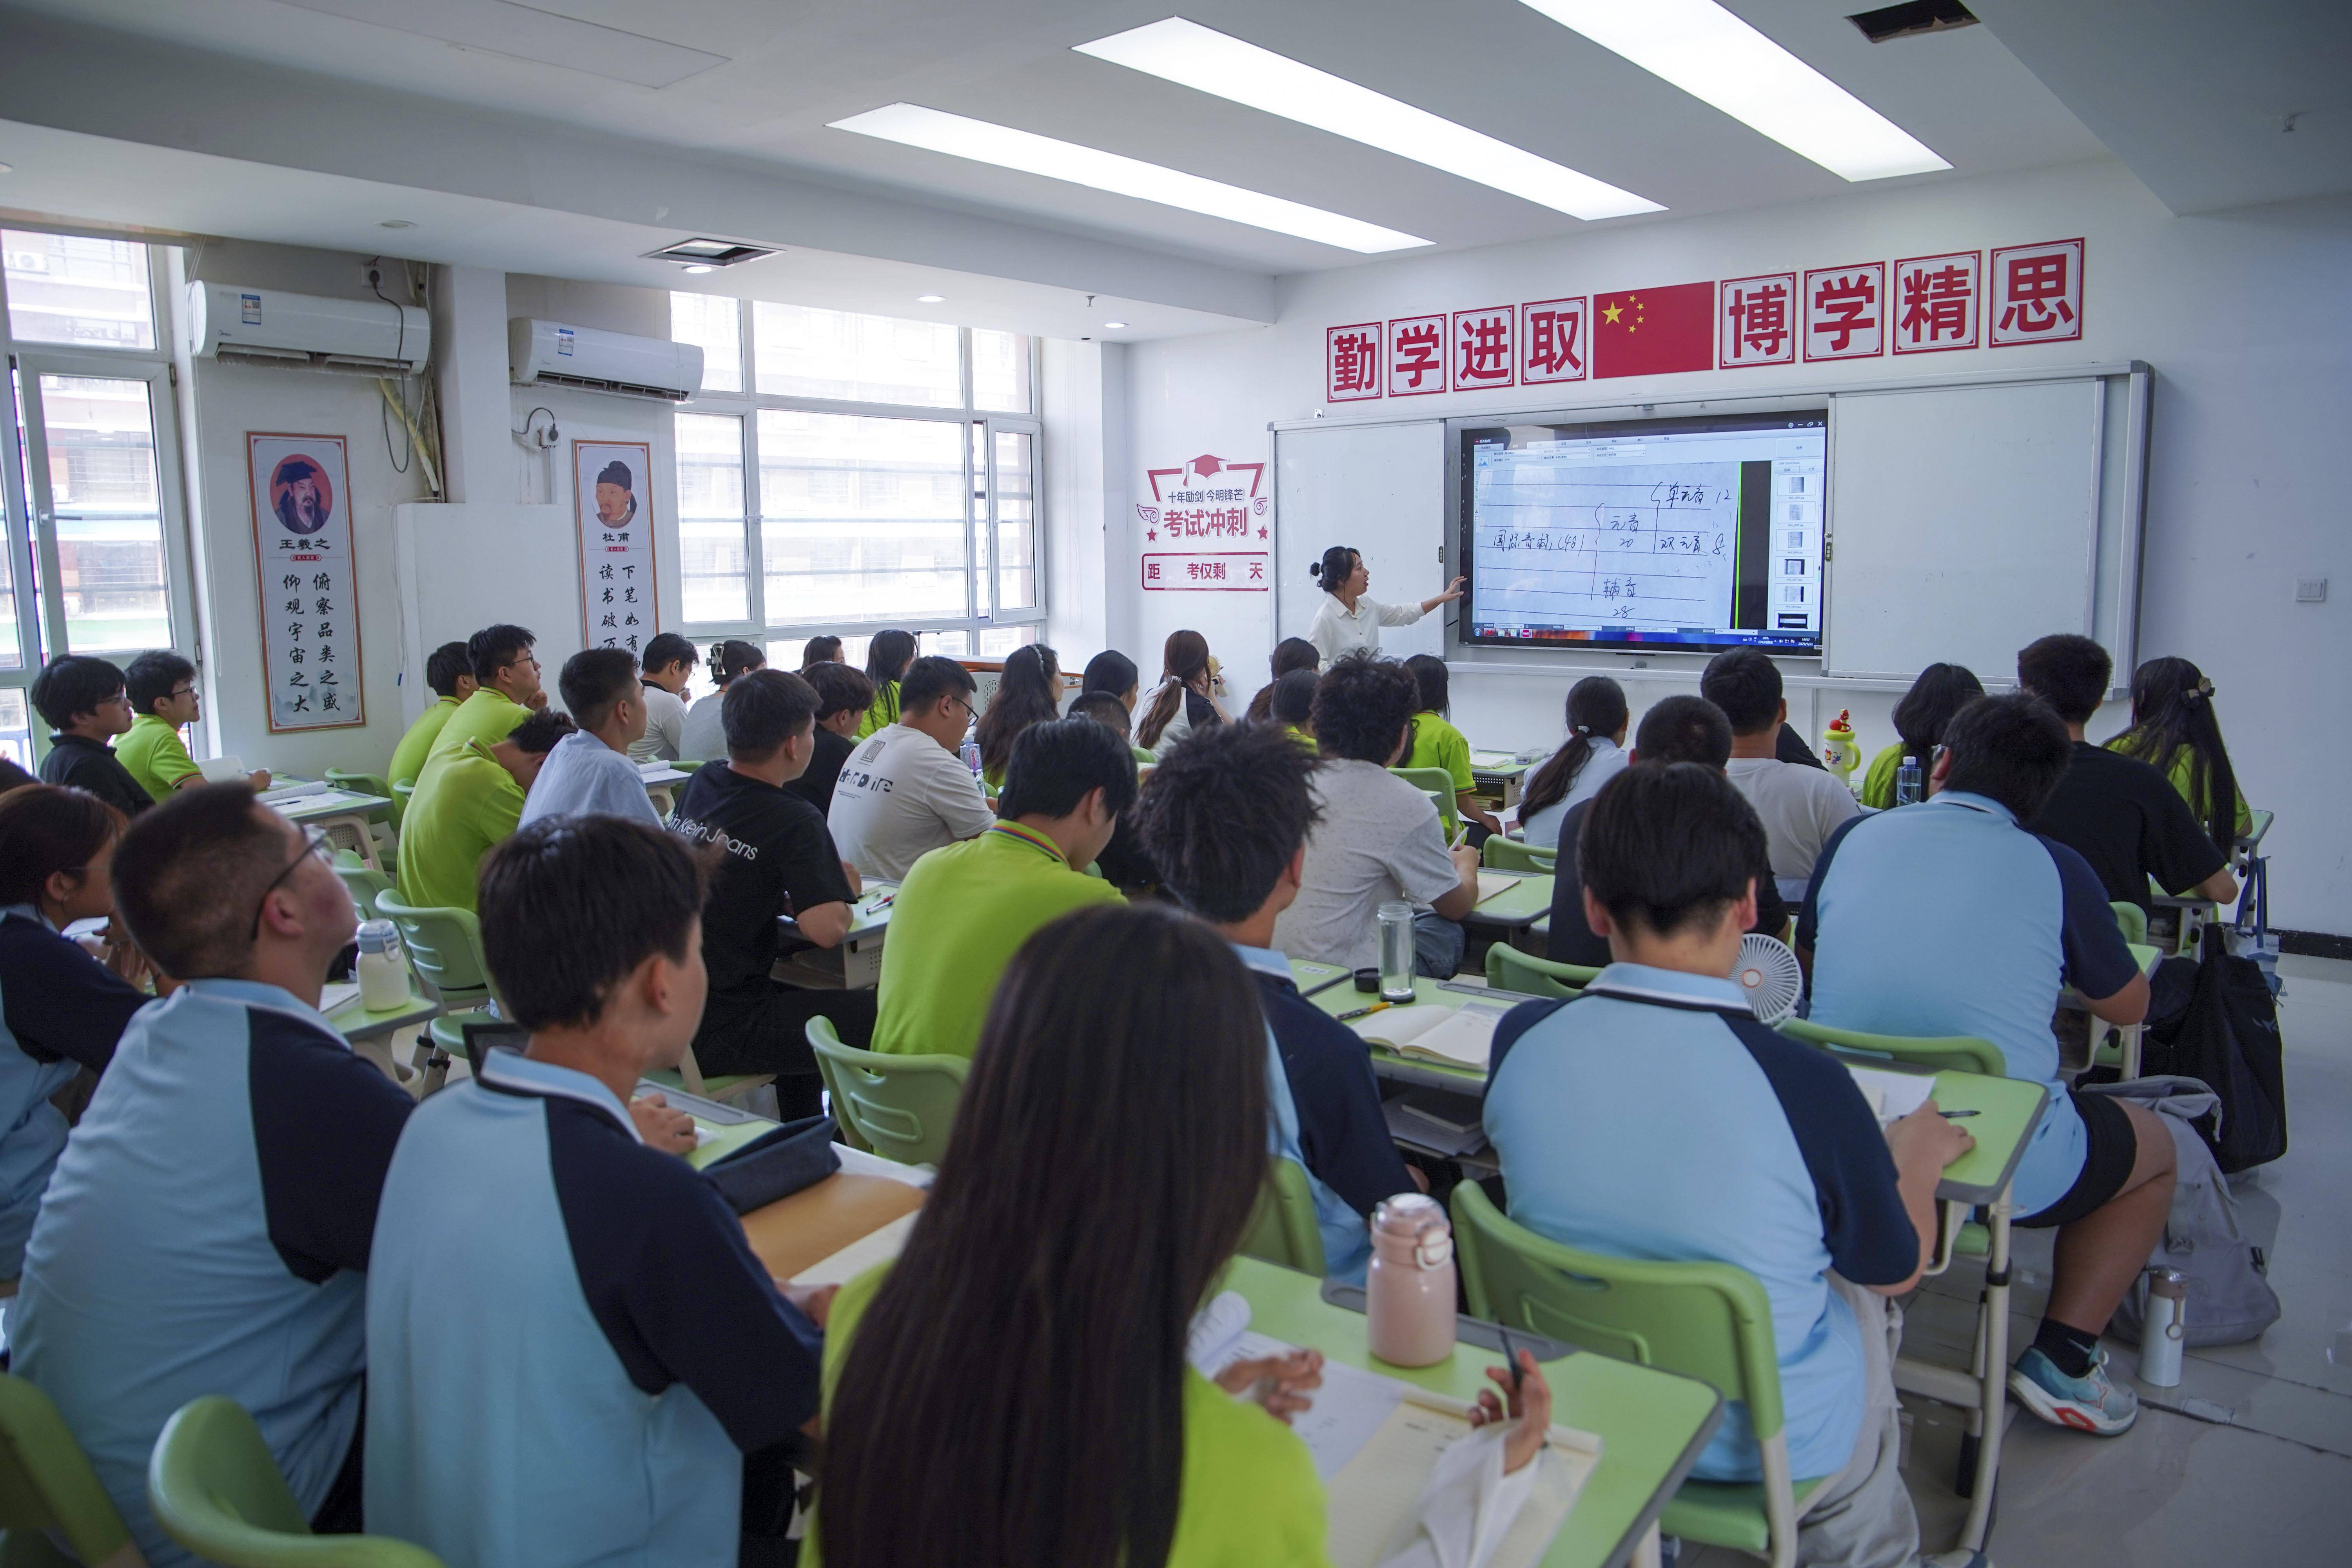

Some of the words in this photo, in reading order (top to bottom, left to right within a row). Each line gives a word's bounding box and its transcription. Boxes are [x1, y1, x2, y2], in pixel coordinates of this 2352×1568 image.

[1334, 311, 1581, 392] 勤学进取
[1729, 254, 2073, 358] 博学精思
[1168, 491, 1203, 503] 十年励剑
[1206, 488, 1243, 502] 今明锋芒
[1666, 481, 1703, 508] 单元音
[1715, 490, 1731, 504] 12
[1164, 507, 1247, 537] 考试冲刺
[1610, 512, 1639, 532] 元音
[279, 538, 331, 550] 王羲之
[603, 533, 630, 542] 杜甫
[1620, 538, 1633, 547] 20
[1661, 532, 1700, 553] 双元音
[1148, 563, 1160, 579] 距
[1187, 563, 1226, 580] 考仅剩
[1249, 562, 1263, 579] 天
[1613, 606, 1635, 618] 28
[283, 573, 309, 712] 仰观宇宙之大
[313, 573, 340, 711] 俯察品类之盛
[677, 817, 707, 839] Klein
